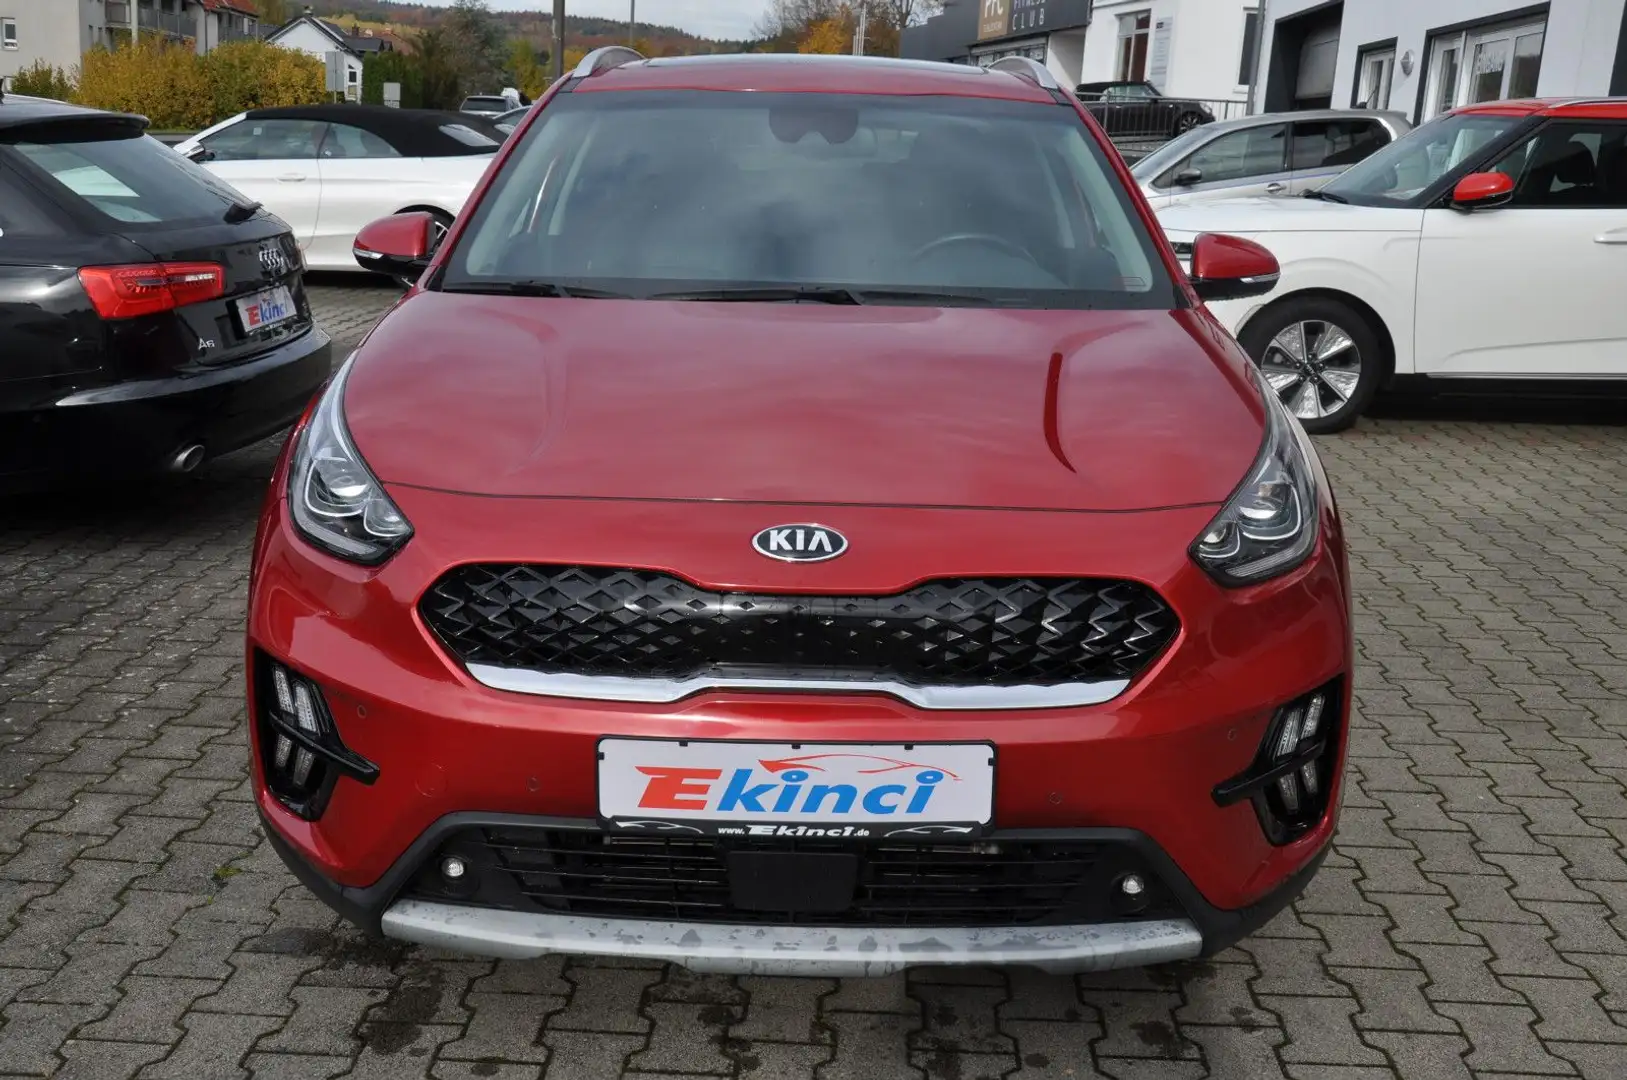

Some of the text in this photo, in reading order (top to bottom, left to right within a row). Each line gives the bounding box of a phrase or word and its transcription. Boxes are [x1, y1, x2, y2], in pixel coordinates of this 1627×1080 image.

[1012, 8, 1045, 31] CLUB
[245, 300, 287, 327] Ekinc
[198, 337, 215, 351] A6
[769, 529, 833, 553] KIA
[634, 765, 944, 814] Ekinci
[718, 824, 870, 838] www.Ekinci.de
